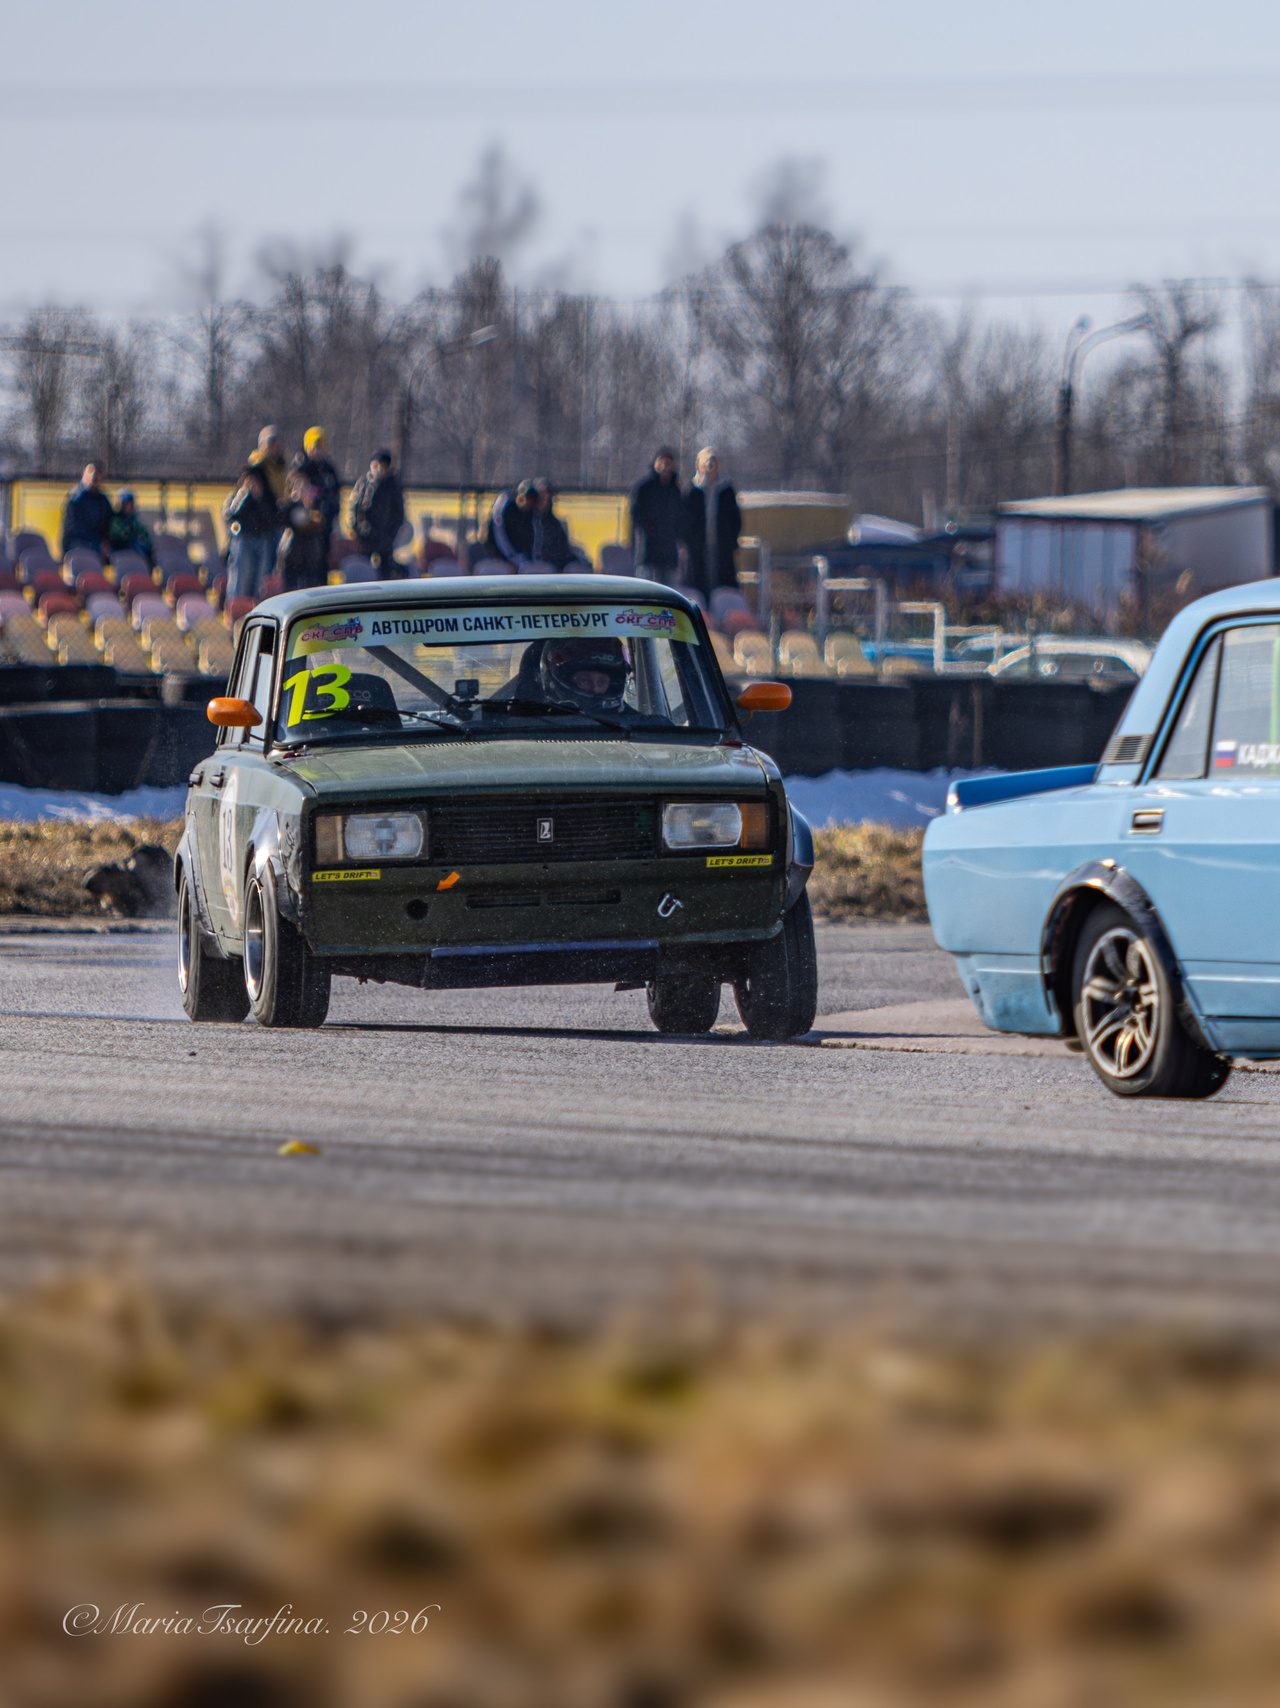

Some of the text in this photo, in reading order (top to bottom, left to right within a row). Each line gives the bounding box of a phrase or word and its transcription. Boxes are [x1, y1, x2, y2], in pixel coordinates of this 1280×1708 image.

[371, 612, 610, 636] АВТОДРОМ САНКТ-ПЕТЕРБУРГ
[282, 663, 352, 728] 13
[736, 857, 763, 865] DRIFT
